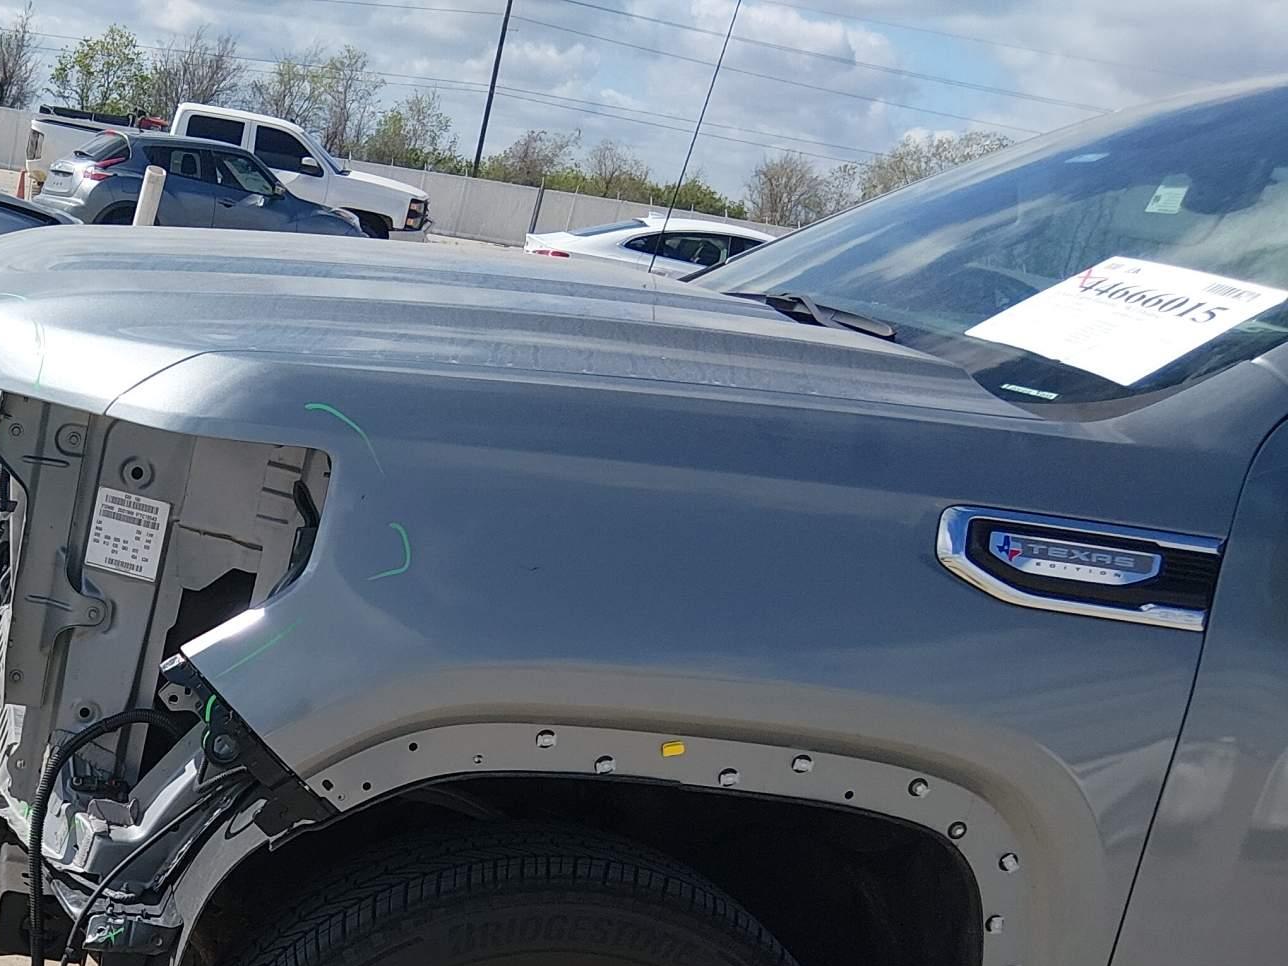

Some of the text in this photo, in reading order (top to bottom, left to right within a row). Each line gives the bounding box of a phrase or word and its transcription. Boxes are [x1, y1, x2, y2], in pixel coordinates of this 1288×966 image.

[1079, 278, 1230, 324] 44666015
[1027, 543, 1135, 568] TEXAS
[1035, 561, 1122, 579] EDITION
